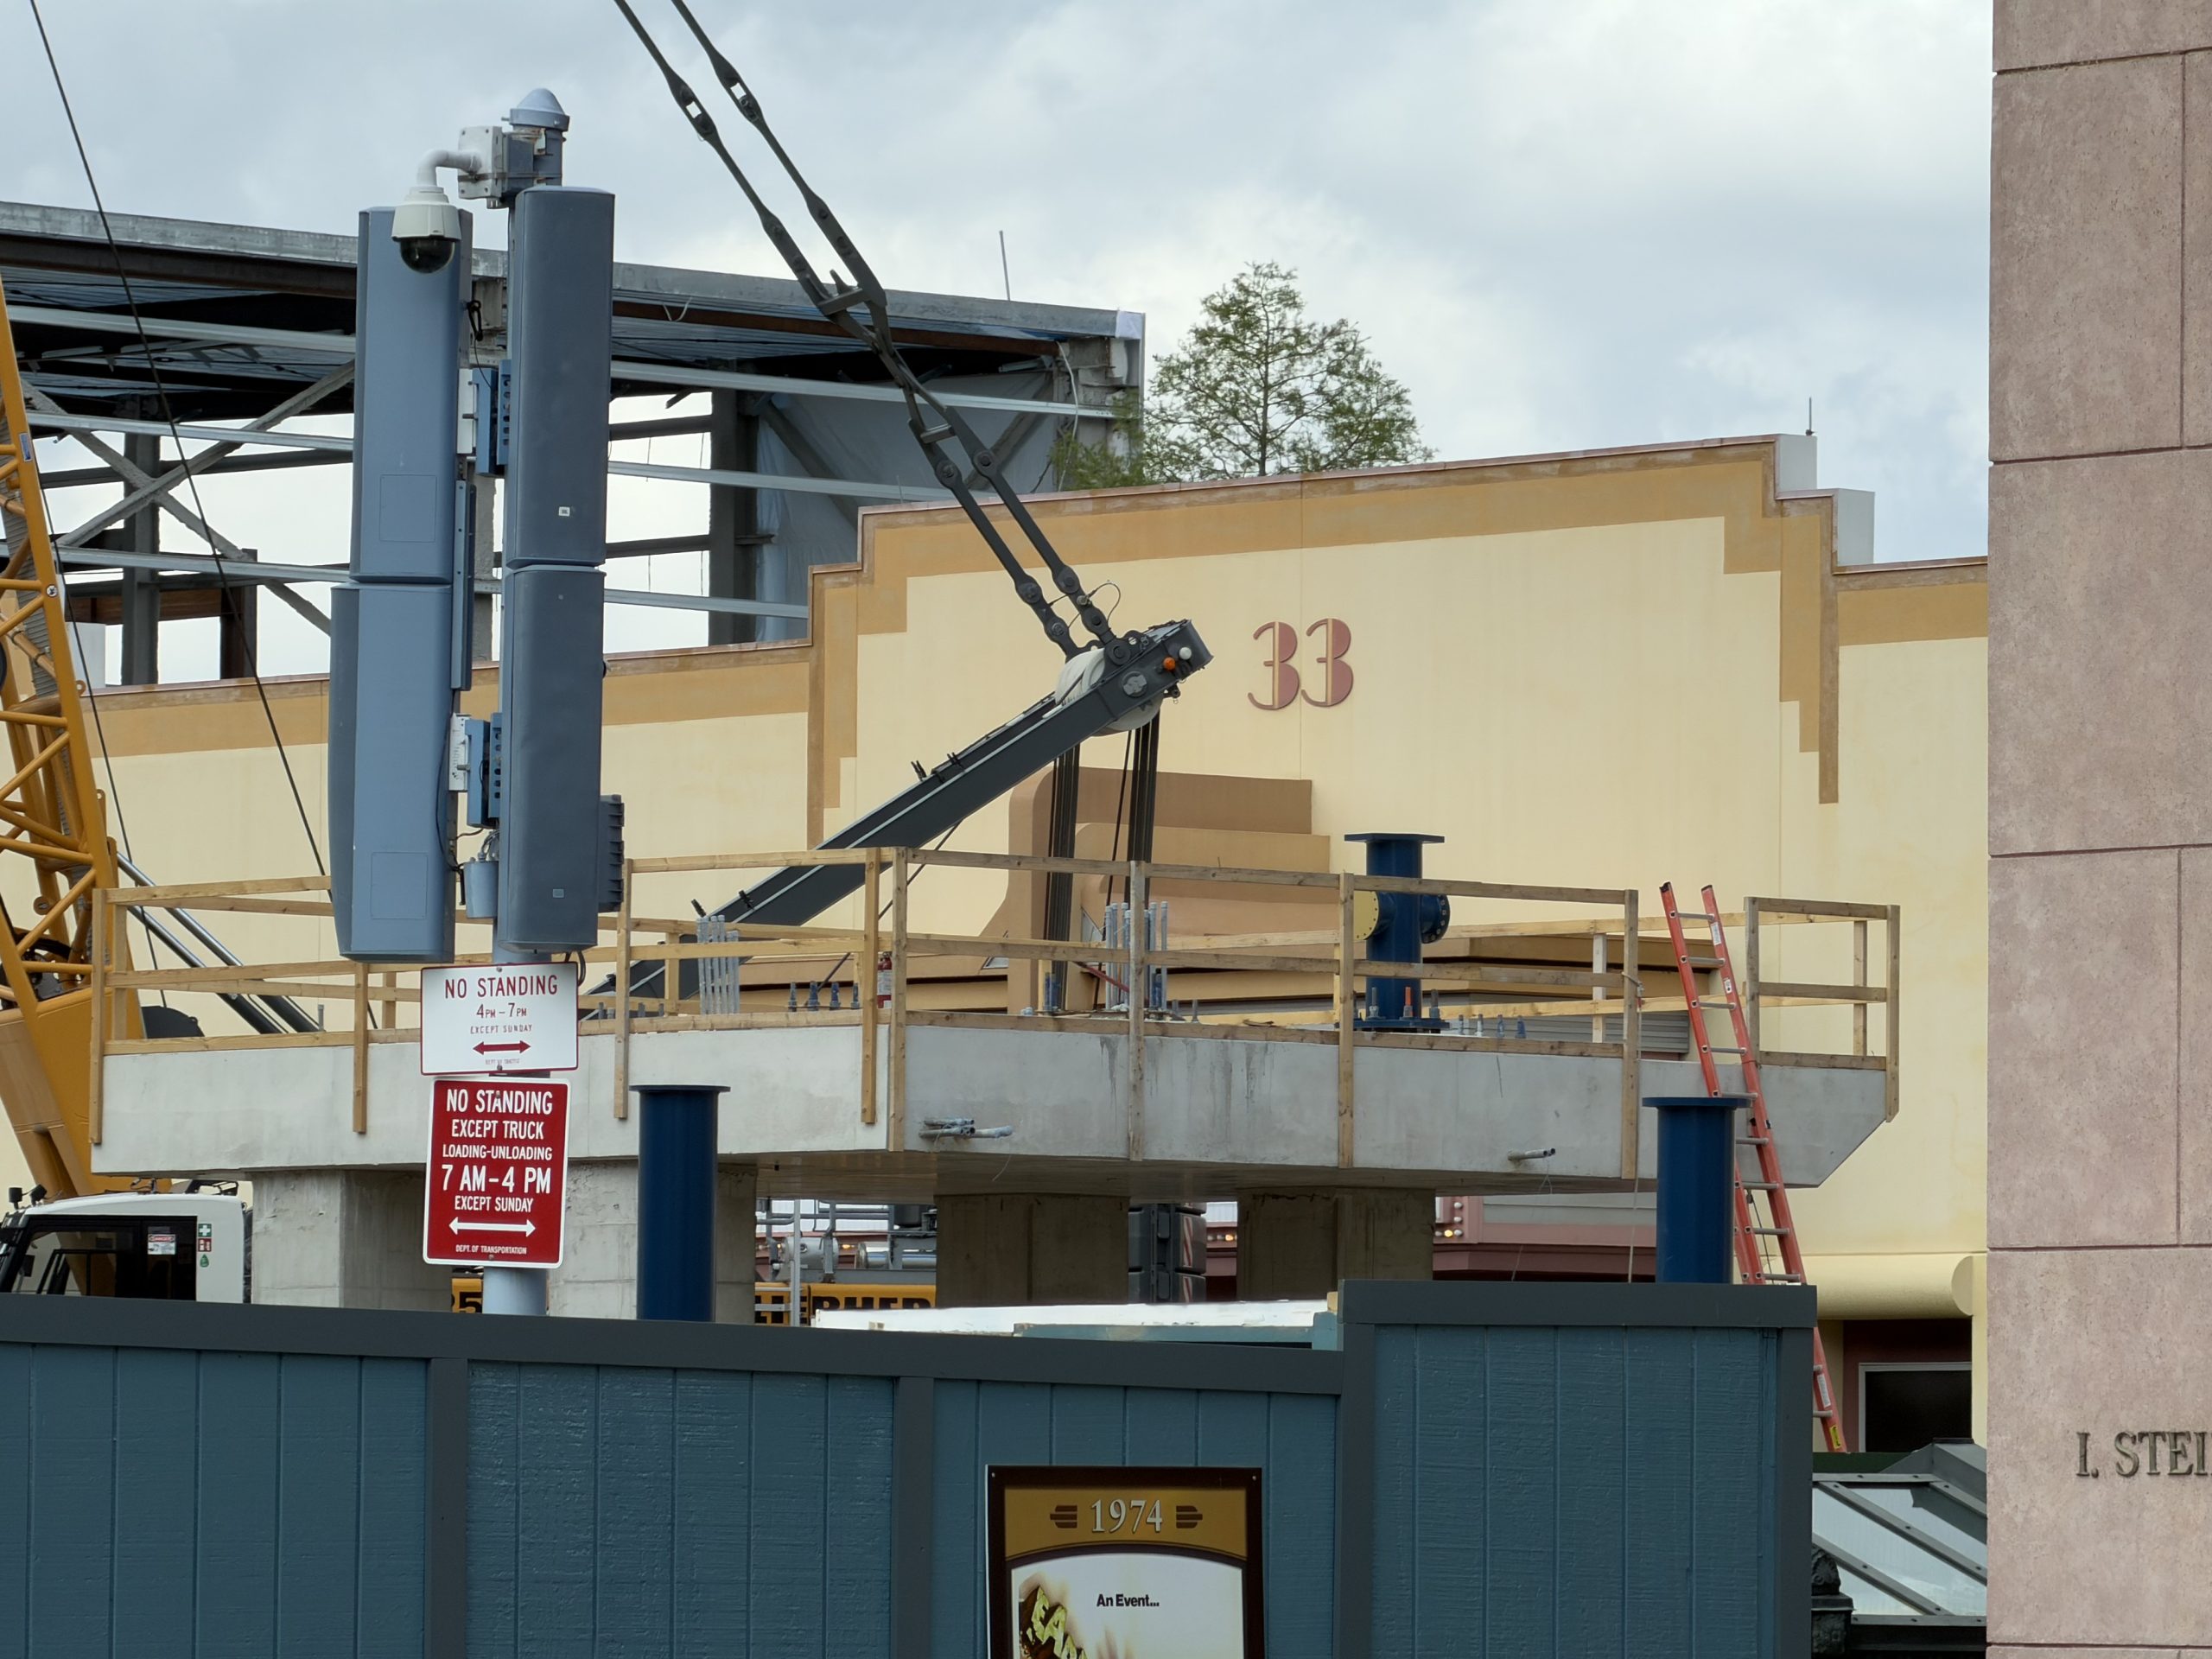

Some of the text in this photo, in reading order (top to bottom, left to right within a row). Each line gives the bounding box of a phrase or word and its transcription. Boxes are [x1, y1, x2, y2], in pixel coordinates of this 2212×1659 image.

[1248, 618, 1354, 710] 33
[445, 975, 557, 999] NO STANDING
[470, 1024, 532, 1034] EXCEPT SUNDAY
[446, 1089, 553, 1115] NO STANDING
[451, 1119, 544, 1140] EXCEPT TRUCK
[442, 1144, 553, 1160] LOADING-UNLOADING
[442, 1164, 454, 1191] 7
[524, 1167, 551, 1194] PM
[454, 1195, 534, 1213] EXCEPT SUNDAY
[480, 1245, 527, 1255] TRANSPORTATION
[2114, 1431, 2212, 1478] STEI
[1090, 1499, 1163, 1533] 1974
[1096, 1594, 1160, 1607] An Event...
